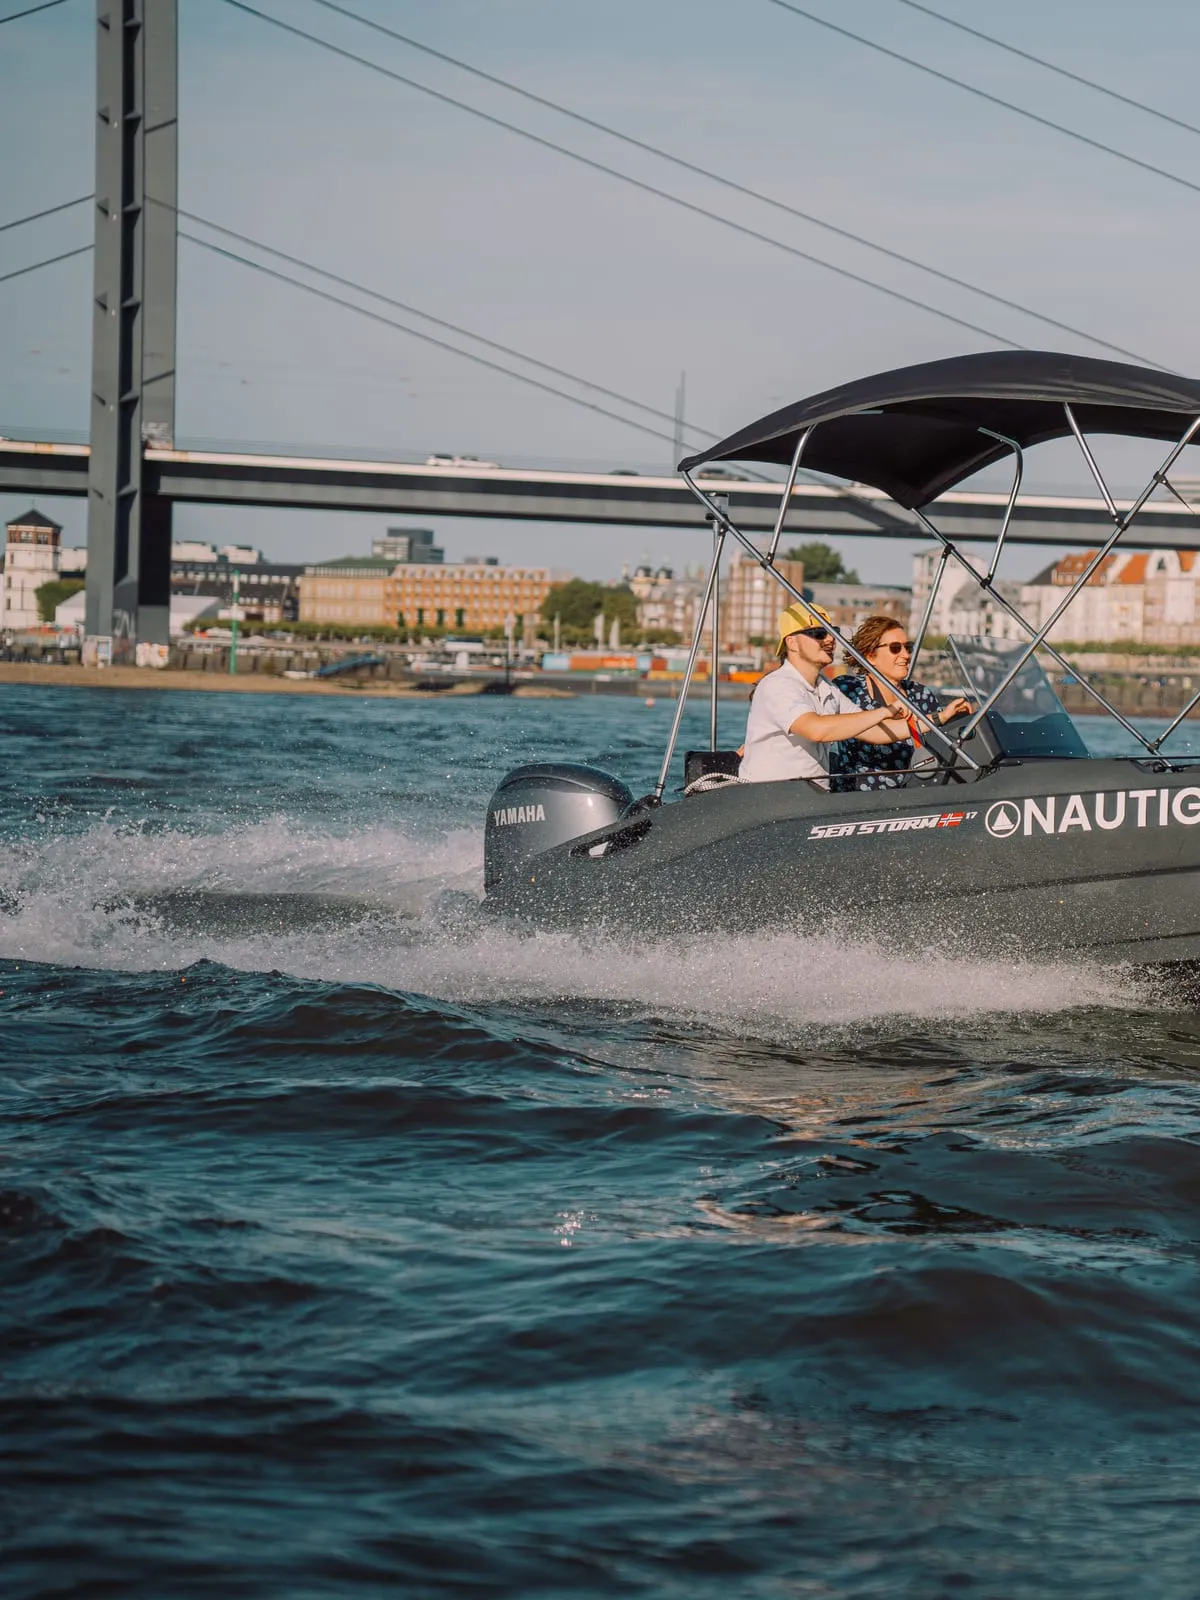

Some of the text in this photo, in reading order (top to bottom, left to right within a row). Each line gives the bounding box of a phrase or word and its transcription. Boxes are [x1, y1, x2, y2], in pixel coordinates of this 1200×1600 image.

[494, 804, 546, 827] YAMAHA
[807, 811, 978, 840] SEA STORM 17
